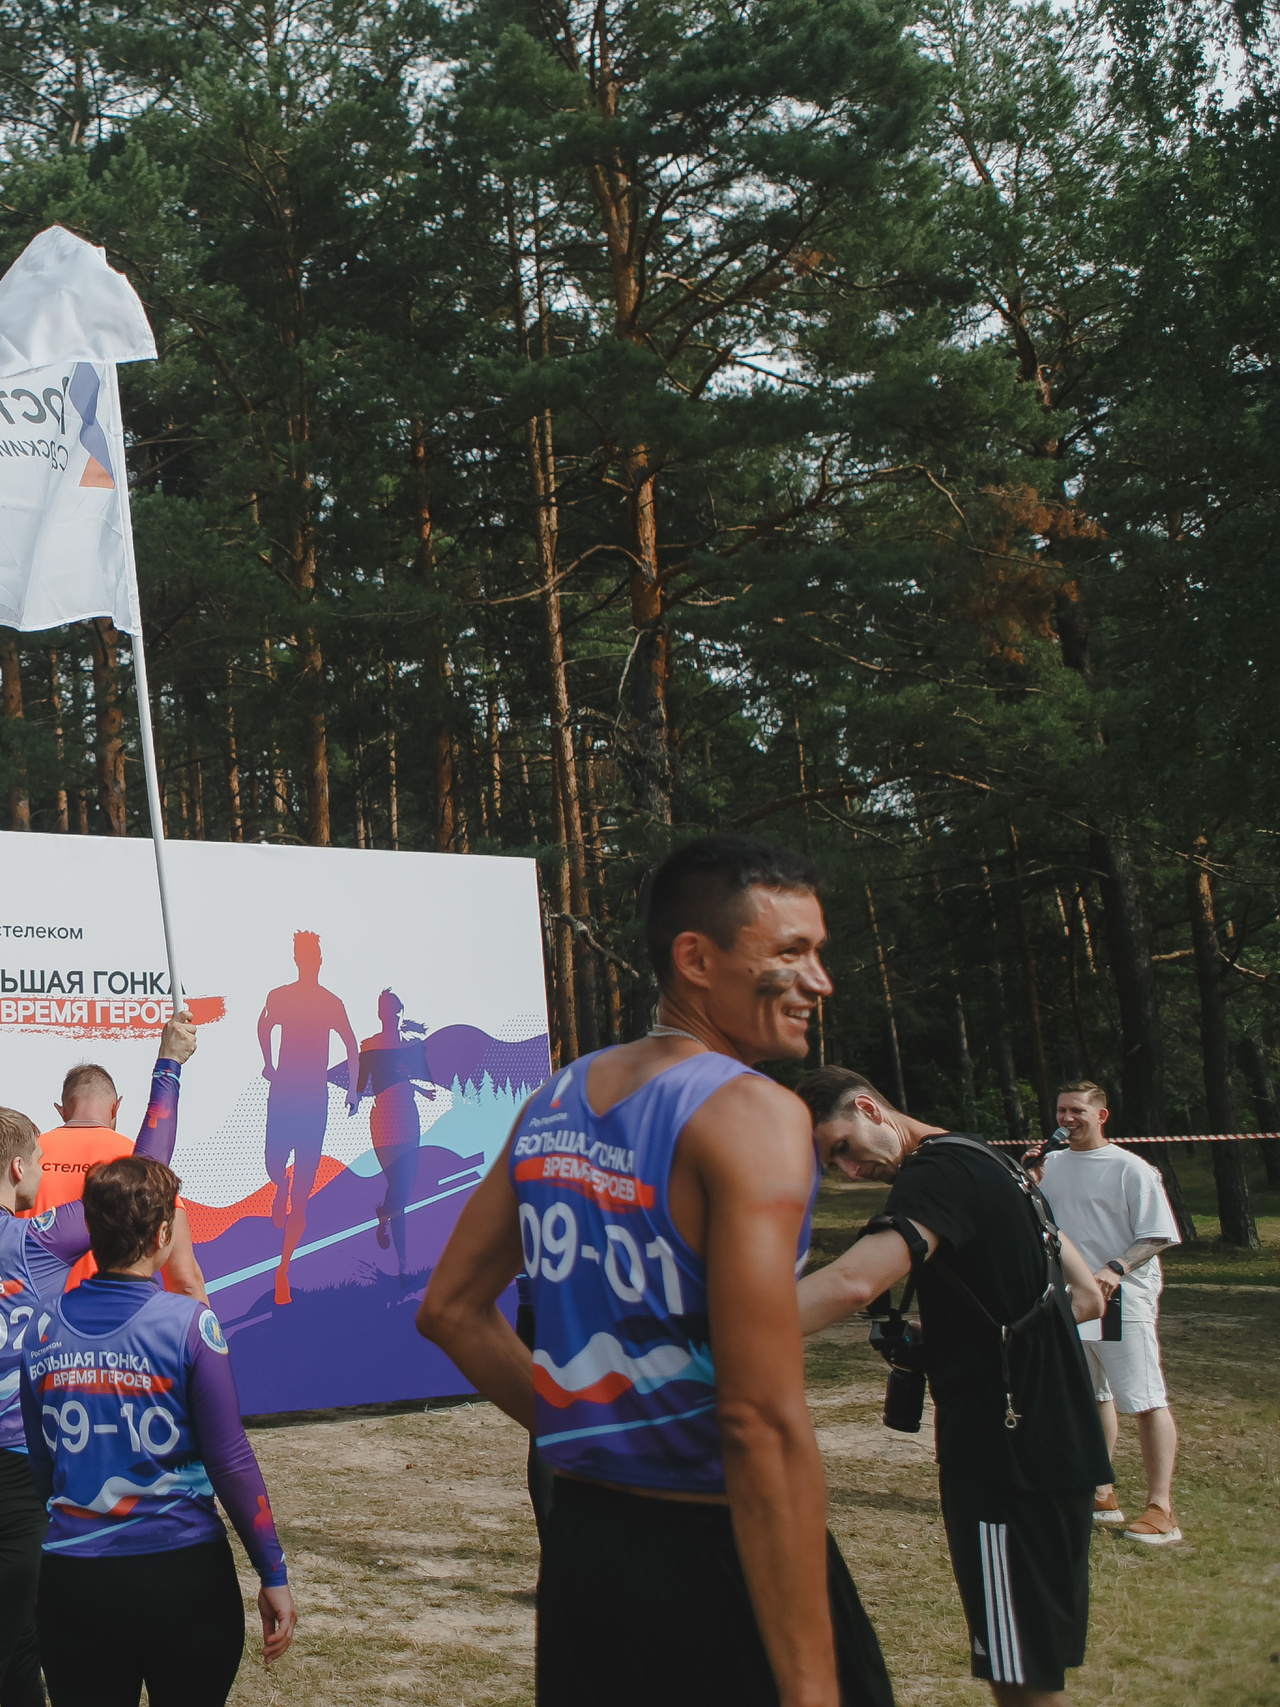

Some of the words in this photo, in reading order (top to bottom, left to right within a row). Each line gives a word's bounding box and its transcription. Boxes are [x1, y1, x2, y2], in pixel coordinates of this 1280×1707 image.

[1, 1000, 88, 1024] ВРЕМЯ
[514, 1130, 588, 1156] БОЛЬША
[41, 1162, 91, 1173] стеле
[519, 1201, 684, 1315] 09-01
[99, 1352, 150, 1373] ГОНКА
[53, 1369, 96, 1387] ВРЕМЯ
[100, 1369, 151, 1390] ГЕРОЕВ
